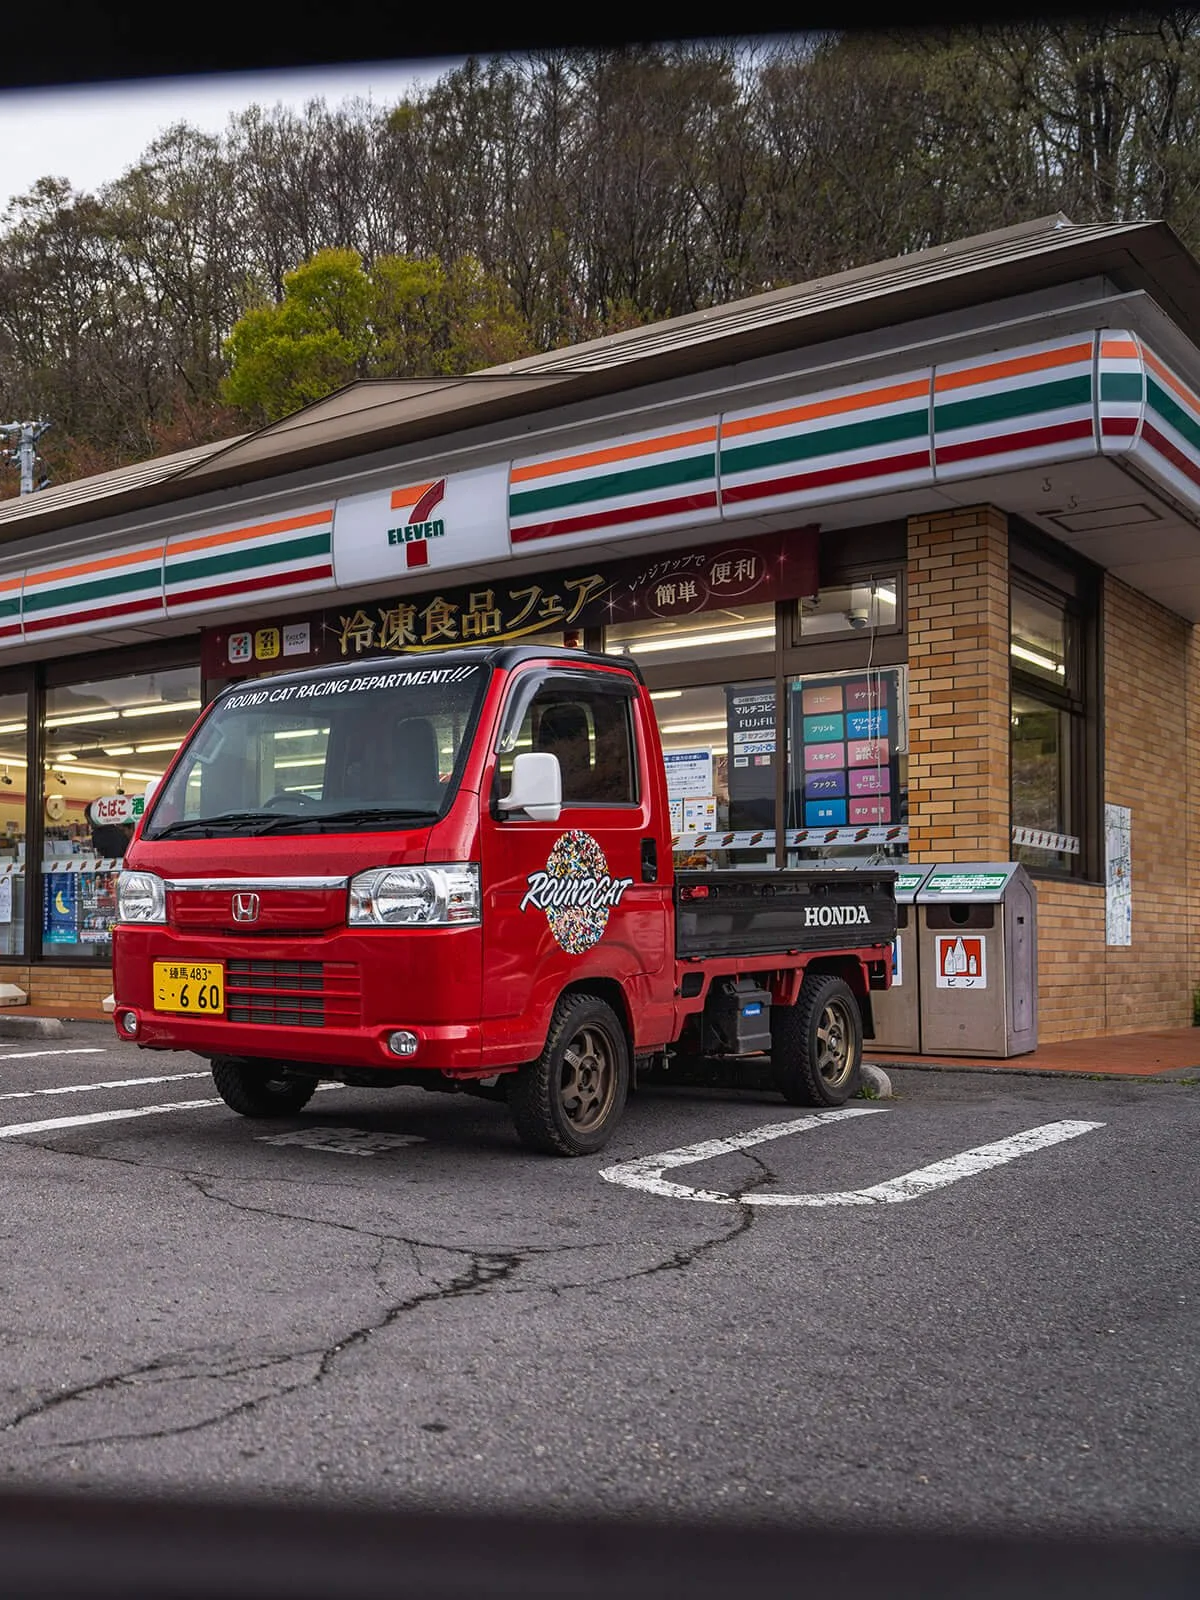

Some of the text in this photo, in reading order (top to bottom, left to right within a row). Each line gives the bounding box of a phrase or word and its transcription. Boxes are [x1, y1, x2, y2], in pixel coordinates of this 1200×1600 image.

[628, 554, 706, 591] レンジアップで
[709, 557, 757, 586] 便利
[655, 580, 699, 607] 簡単
[338, 573, 606, 655] 冷凍食品フェア
[223, 665, 480, 710] ROUND CAT RACING DEPARTMENT!!!
[811, 724, 835, 733] プリント
[97, 799, 127, 817] たばこ
[131, 797, 145, 815] 酒
[519, 871, 634, 912] ROUNDCAT
[804, 905, 871, 927] HONDA
[190, 967, 208, 981] 483
[947, 977, 975, 987] ビン
[158, 988, 166, 1001] こ
